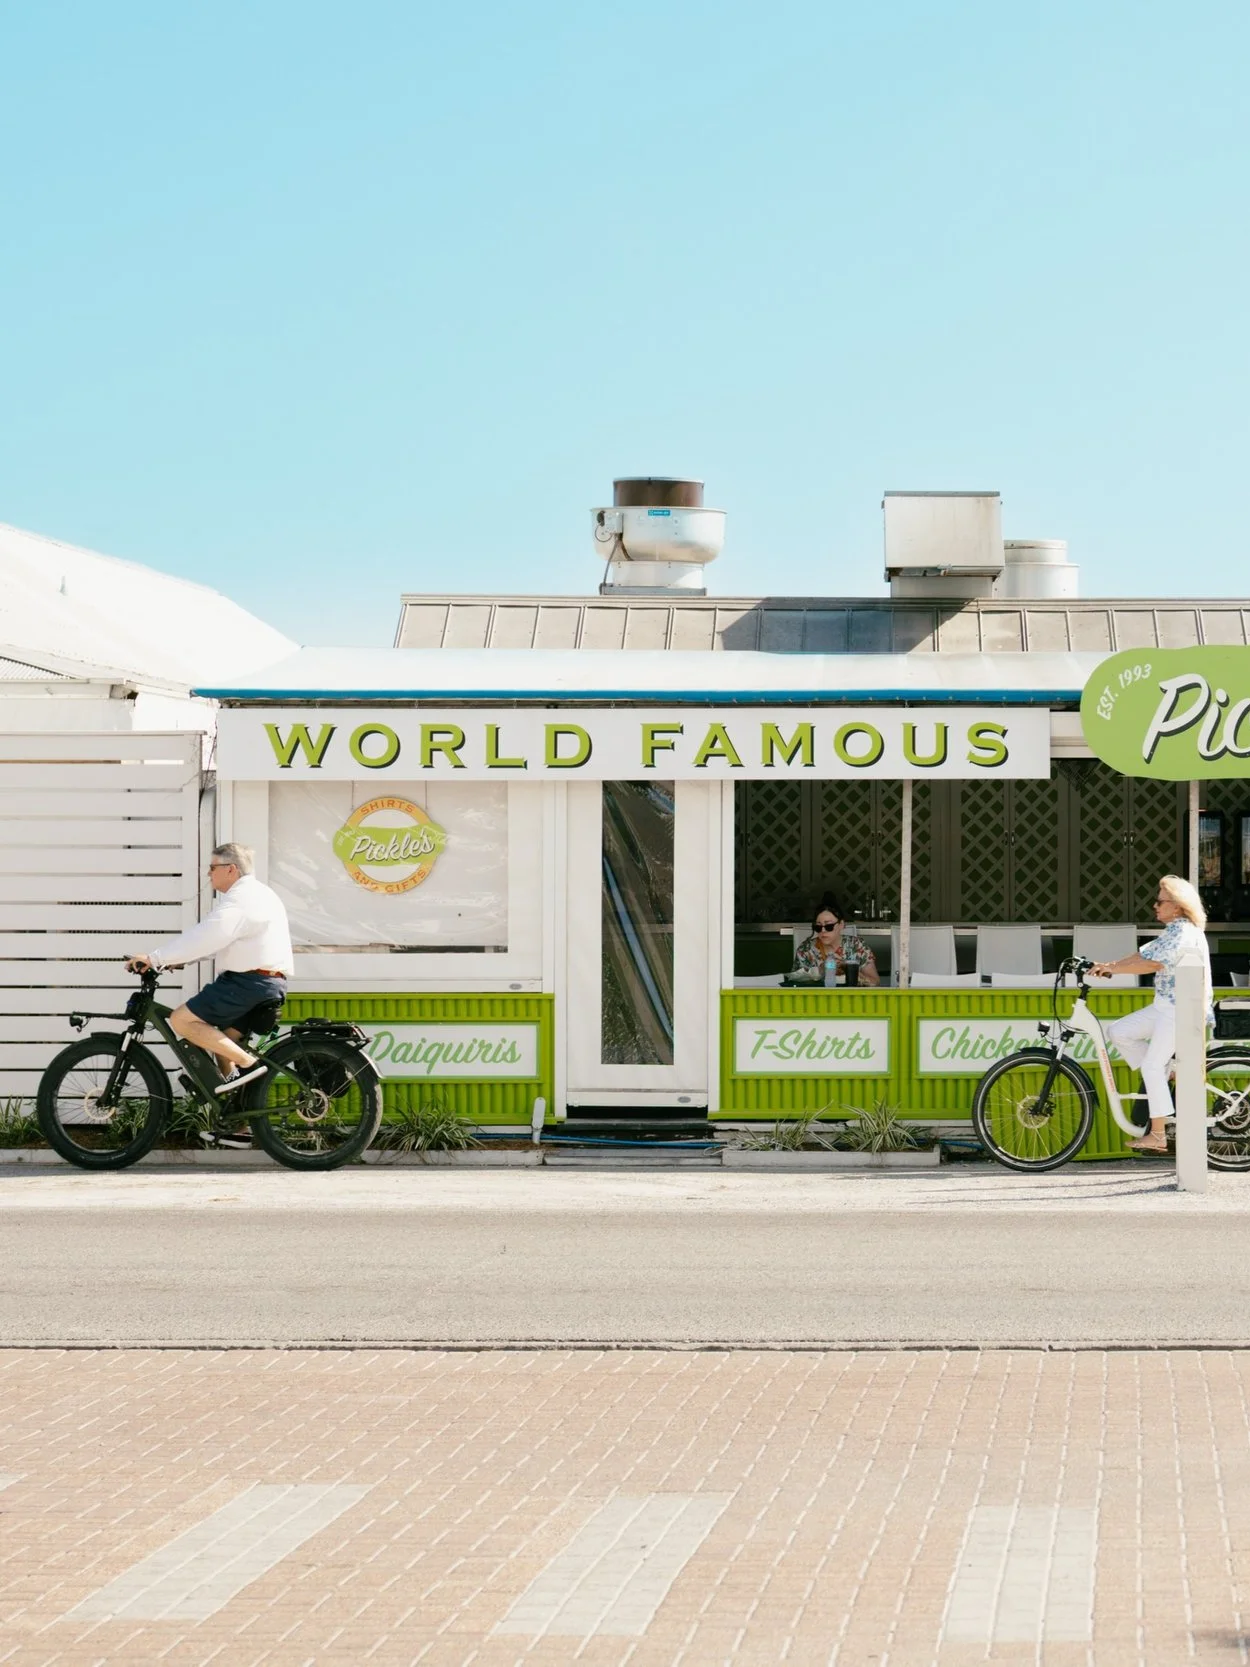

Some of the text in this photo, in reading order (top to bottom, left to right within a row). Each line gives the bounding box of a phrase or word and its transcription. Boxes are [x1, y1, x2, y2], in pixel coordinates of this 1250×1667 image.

[1097, 663, 1152, 720] EST. 1993
[263, 722, 1008, 769] WORLD FAMOUS
[360, 799, 416, 815] SHIRTS
[350, 827, 436, 861] Pickle's
[384, 869, 427, 893] GIFTS
[369, 1030, 522, 1074] Daiquiris
[751, 1027, 876, 1060] T-Shirts
